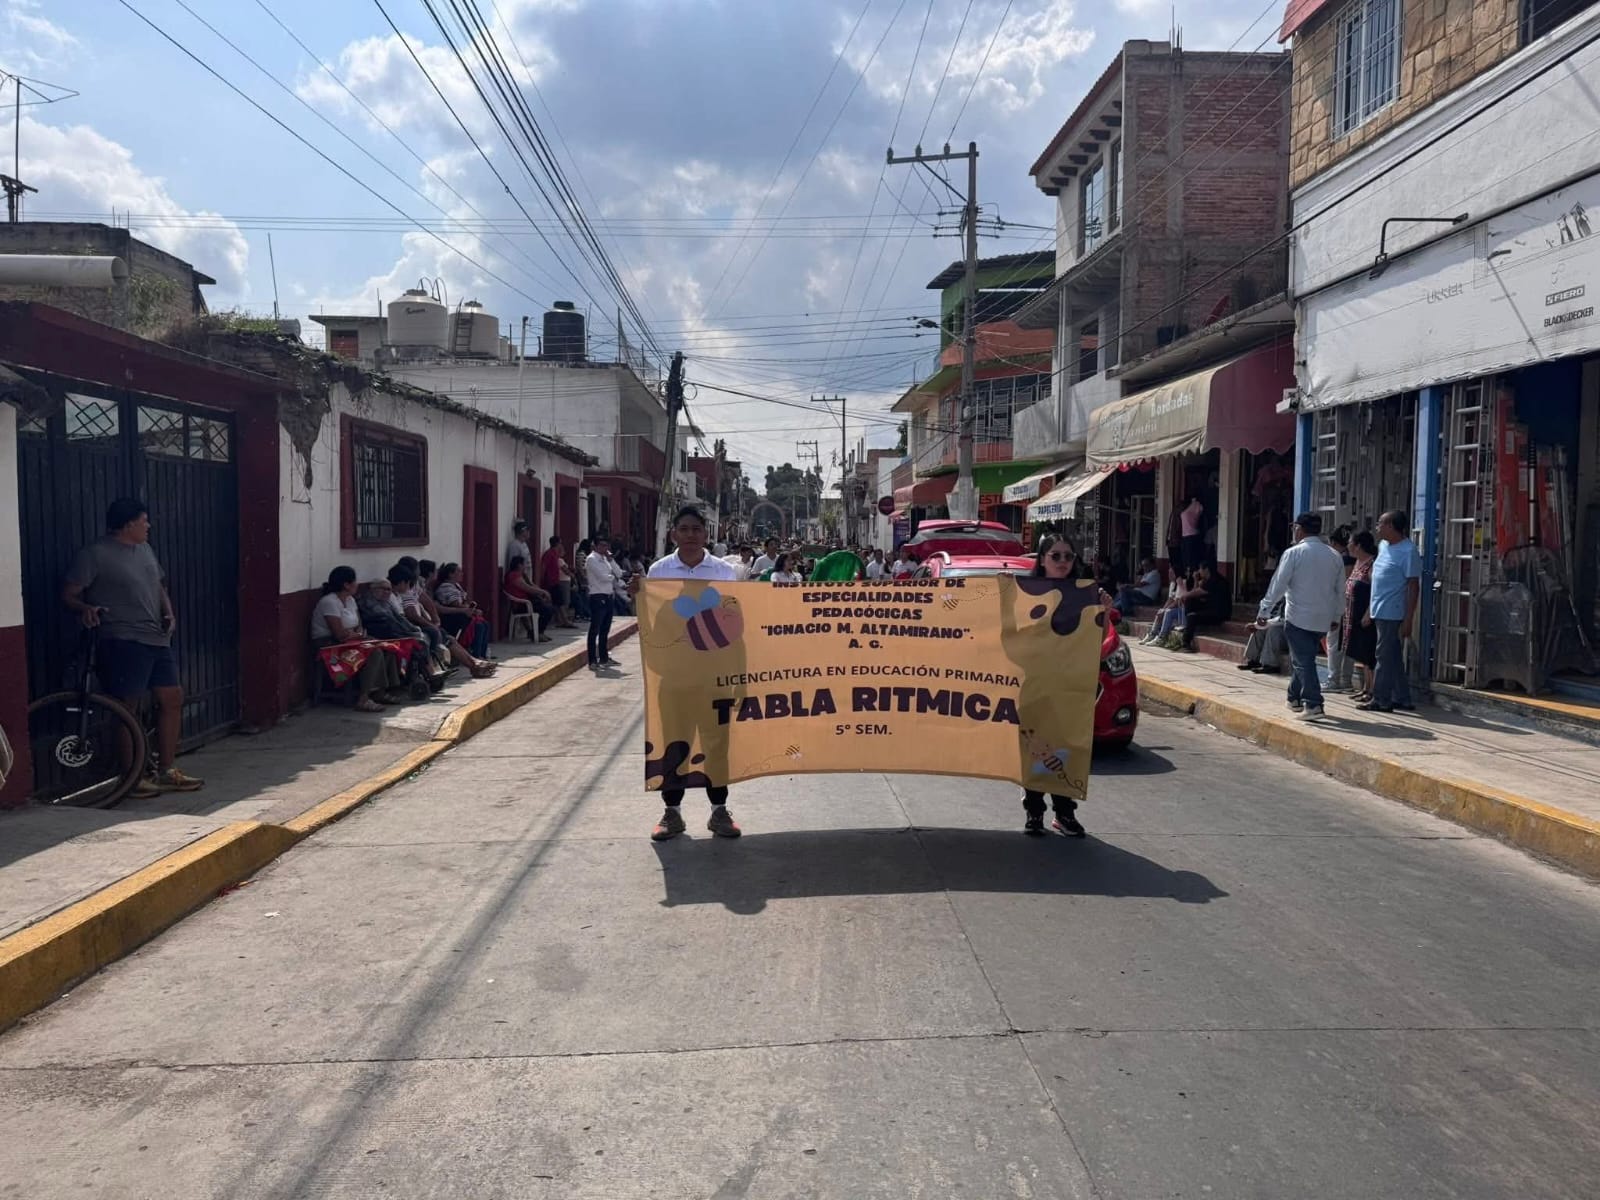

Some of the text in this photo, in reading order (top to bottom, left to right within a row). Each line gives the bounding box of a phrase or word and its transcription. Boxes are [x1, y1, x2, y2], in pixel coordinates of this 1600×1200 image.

[945, 578, 966, 588] DE
[802, 591, 933, 604] ESPECIALIDADES
[812, 604, 923, 620] PEDAGÓGICAS
[837, 623, 854, 635] M.
[848, 638, 862, 649] A.
[717, 664, 1021, 688] LICENCIATURA EN EDUCACIÓN PRIMARIA
[712, 686, 1021, 726] TABLA RITMICA
[855, 723, 893, 736] SEM.
